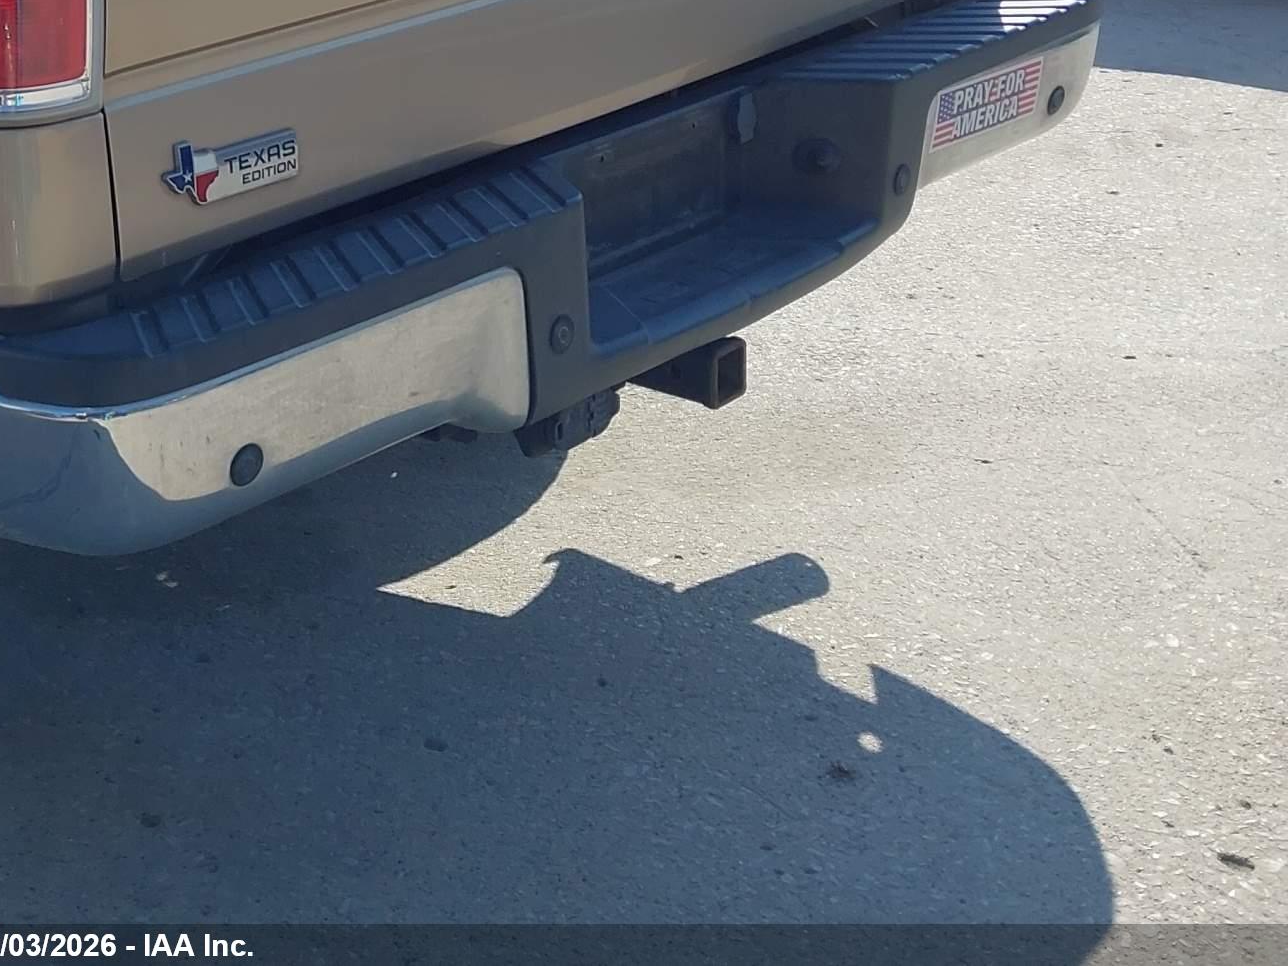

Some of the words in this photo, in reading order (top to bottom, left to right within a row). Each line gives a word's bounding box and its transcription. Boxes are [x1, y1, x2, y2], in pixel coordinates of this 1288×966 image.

[952, 79, 994, 115] PRAY
[996, 69, 1026, 98] FOR
[951, 95, 1019, 139] AMERICA
[224, 139, 297, 174] TEXAS
[242, 159, 297, 185] EDITION
